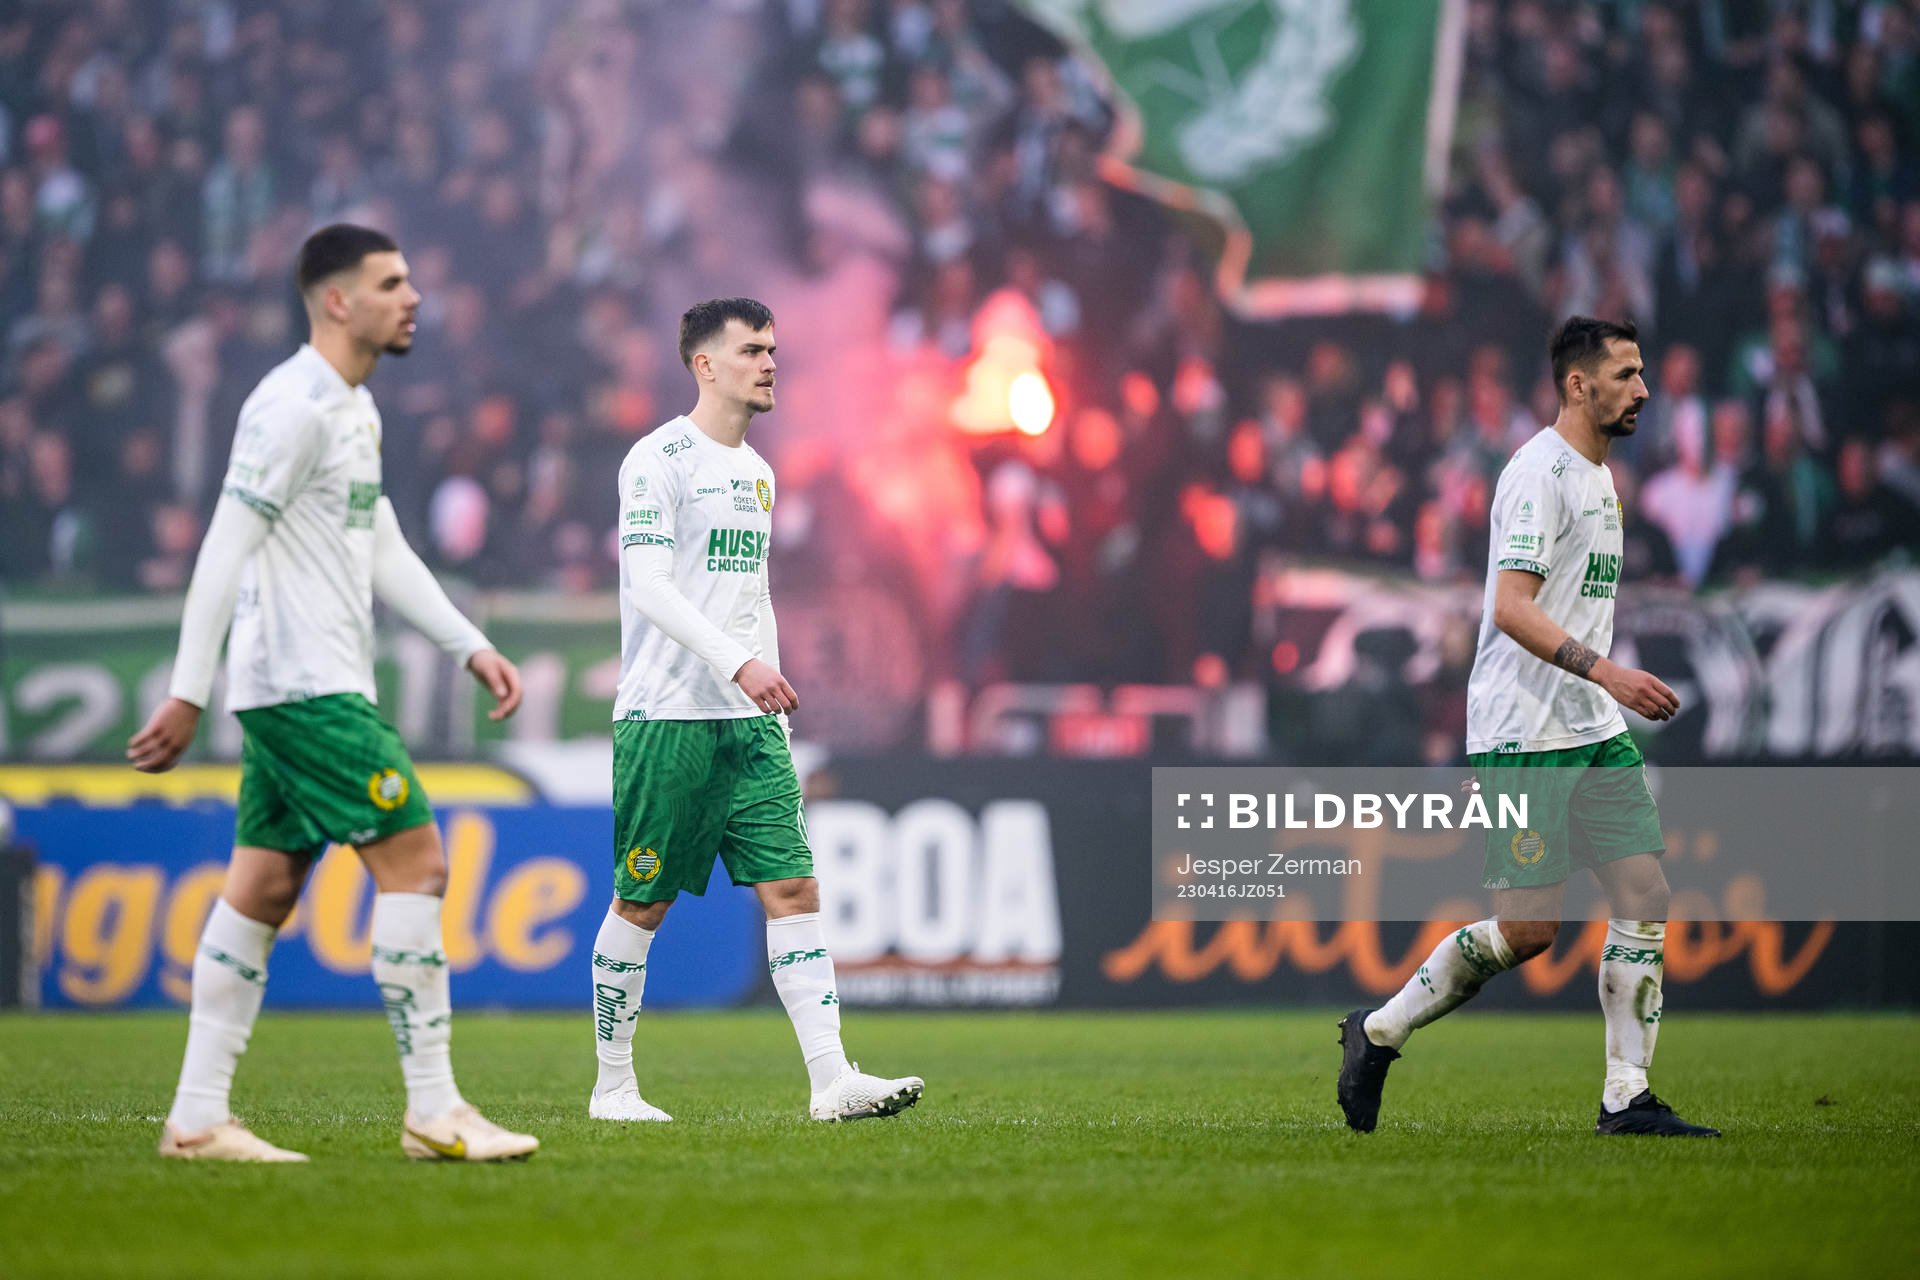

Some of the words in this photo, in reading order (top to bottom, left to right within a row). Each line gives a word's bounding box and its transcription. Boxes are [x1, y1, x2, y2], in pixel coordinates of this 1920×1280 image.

[626, 510, 659, 520] UNIBET
[1506, 534, 1543, 545] UNIBET
[596, 983, 627, 1042] Clinton
